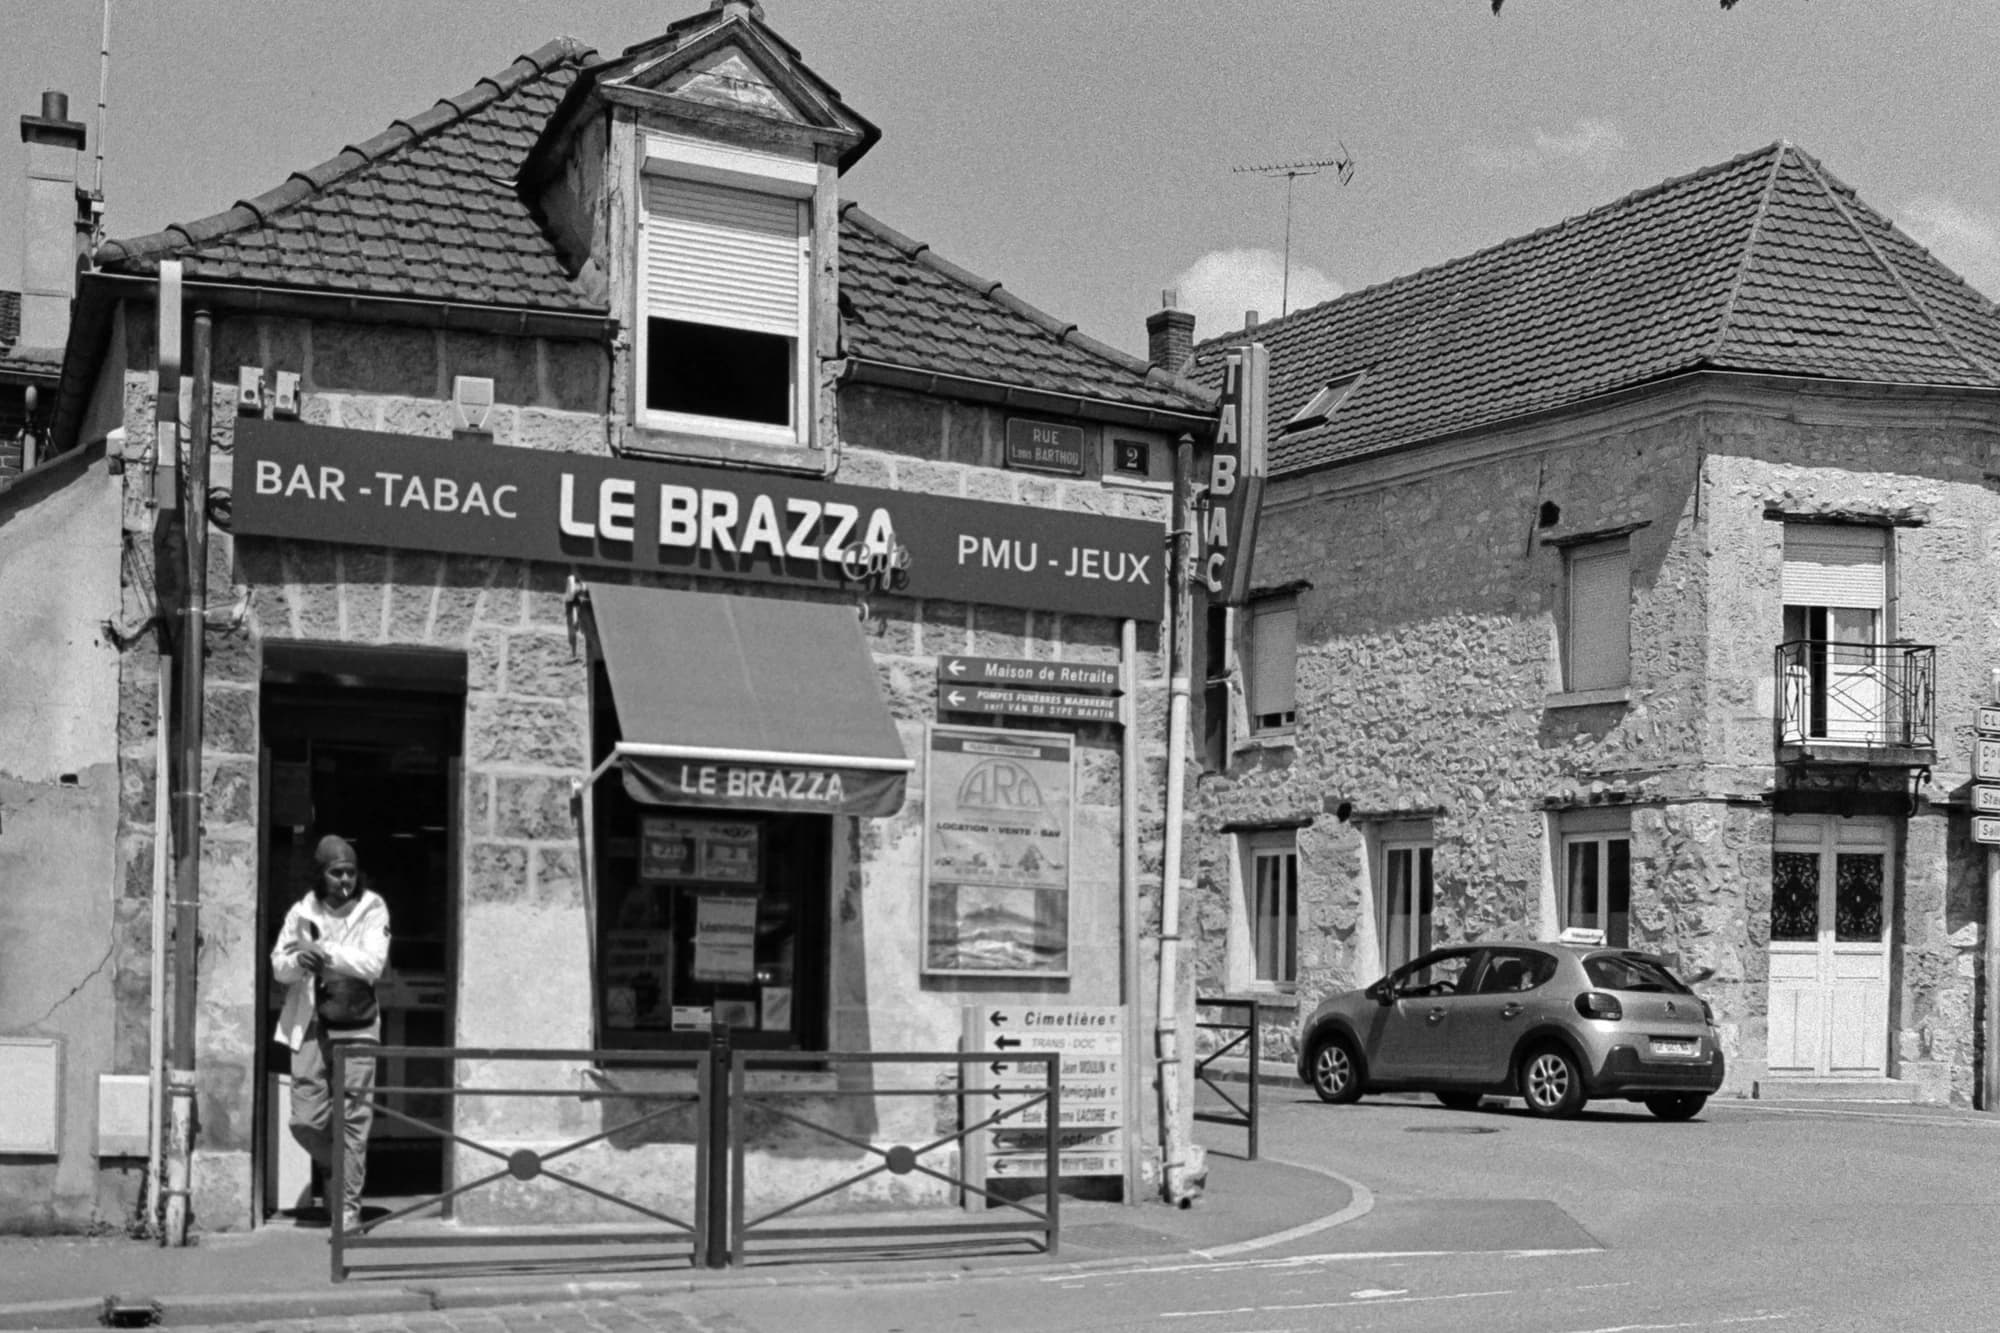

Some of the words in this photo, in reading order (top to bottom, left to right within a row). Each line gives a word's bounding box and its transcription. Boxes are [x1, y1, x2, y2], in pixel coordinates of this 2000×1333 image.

[1033, 428, 1059, 445] RUE
[1126, 447, 1138, 468] 2
[255, 459, 346, 502] BAR
[1206, 354, 1242, 592] TABAC
[559, 473, 636, 542] LE
[658, 484, 900, 570] BRAZZA
[957, 534, 1038, 573] PMU
[1065, 546, 1151, 584] JEUX
[984, 662, 1033, 679] Maison
[1038, 666, 1055, 681] de
[1060, 668, 1114, 684] Retraite
[976, 690, 1013, 702] POMPES
[1008, 703, 1028, 713] VAN
[1032, 704, 1044, 714] DE
[1078, 708, 1114, 719] MARTIN
[680, 764, 716, 795] LE
[727, 768, 846, 801] BRAZZA
[936, 822, 988, 832] LOCATION
[998, 827, 1031, 836] VENTE
[1024, 1011, 1106, 1026] Cimetière
[1031, 1038, 1065, 1049] TRANS
[1073, 1038, 1096, 1049] DOC
